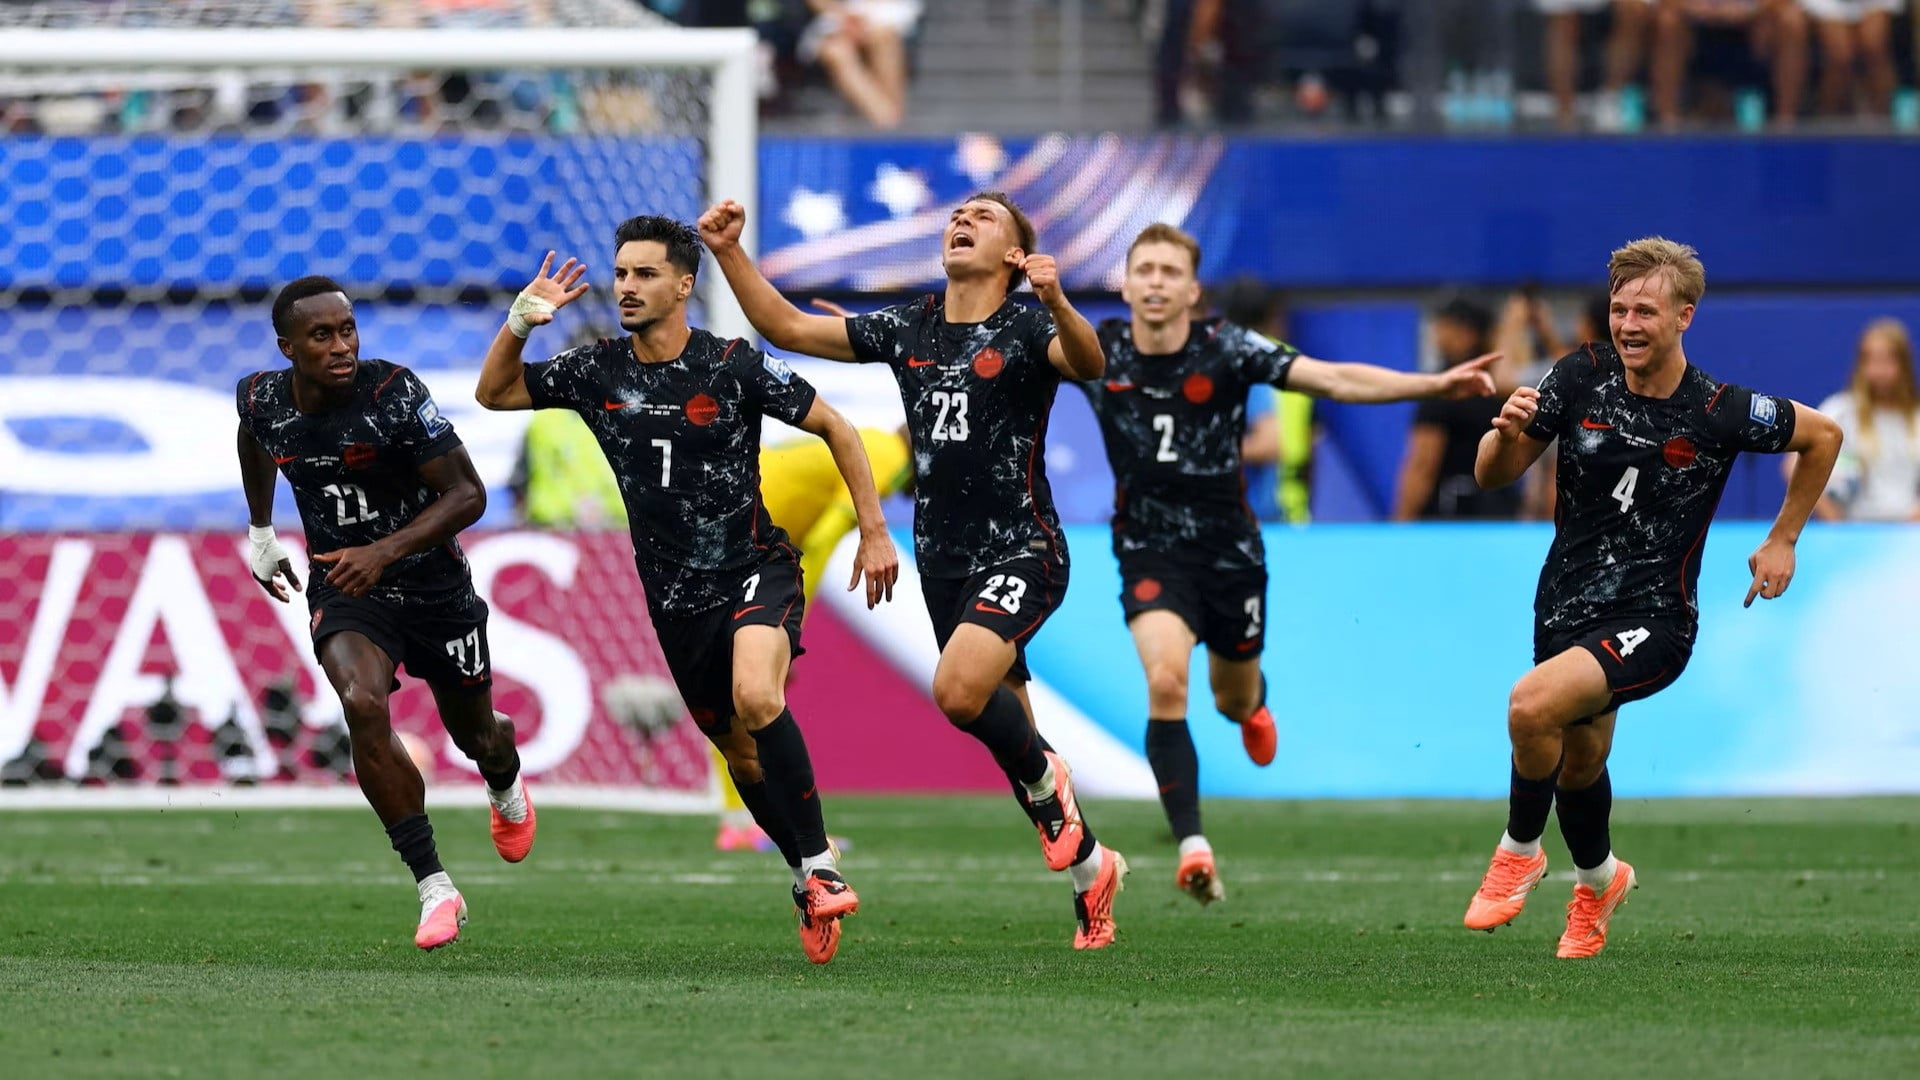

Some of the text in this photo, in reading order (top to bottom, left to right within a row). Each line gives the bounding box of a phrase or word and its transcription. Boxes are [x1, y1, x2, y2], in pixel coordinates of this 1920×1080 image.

[931, 391, 970, 442] 23
[1153, 414, 1179, 463] 2
[651, 438, 672, 488] 7
[323, 483, 380, 527] 22
[1611, 466, 1640, 514] 4
[742, 573, 760, 603] 7
[977, 574, 1028, 615] 23
[1244, 595, 1261, 640] 2
[446, 627, 485, 677] 22
[1616, 626, 1651, 658] 4
